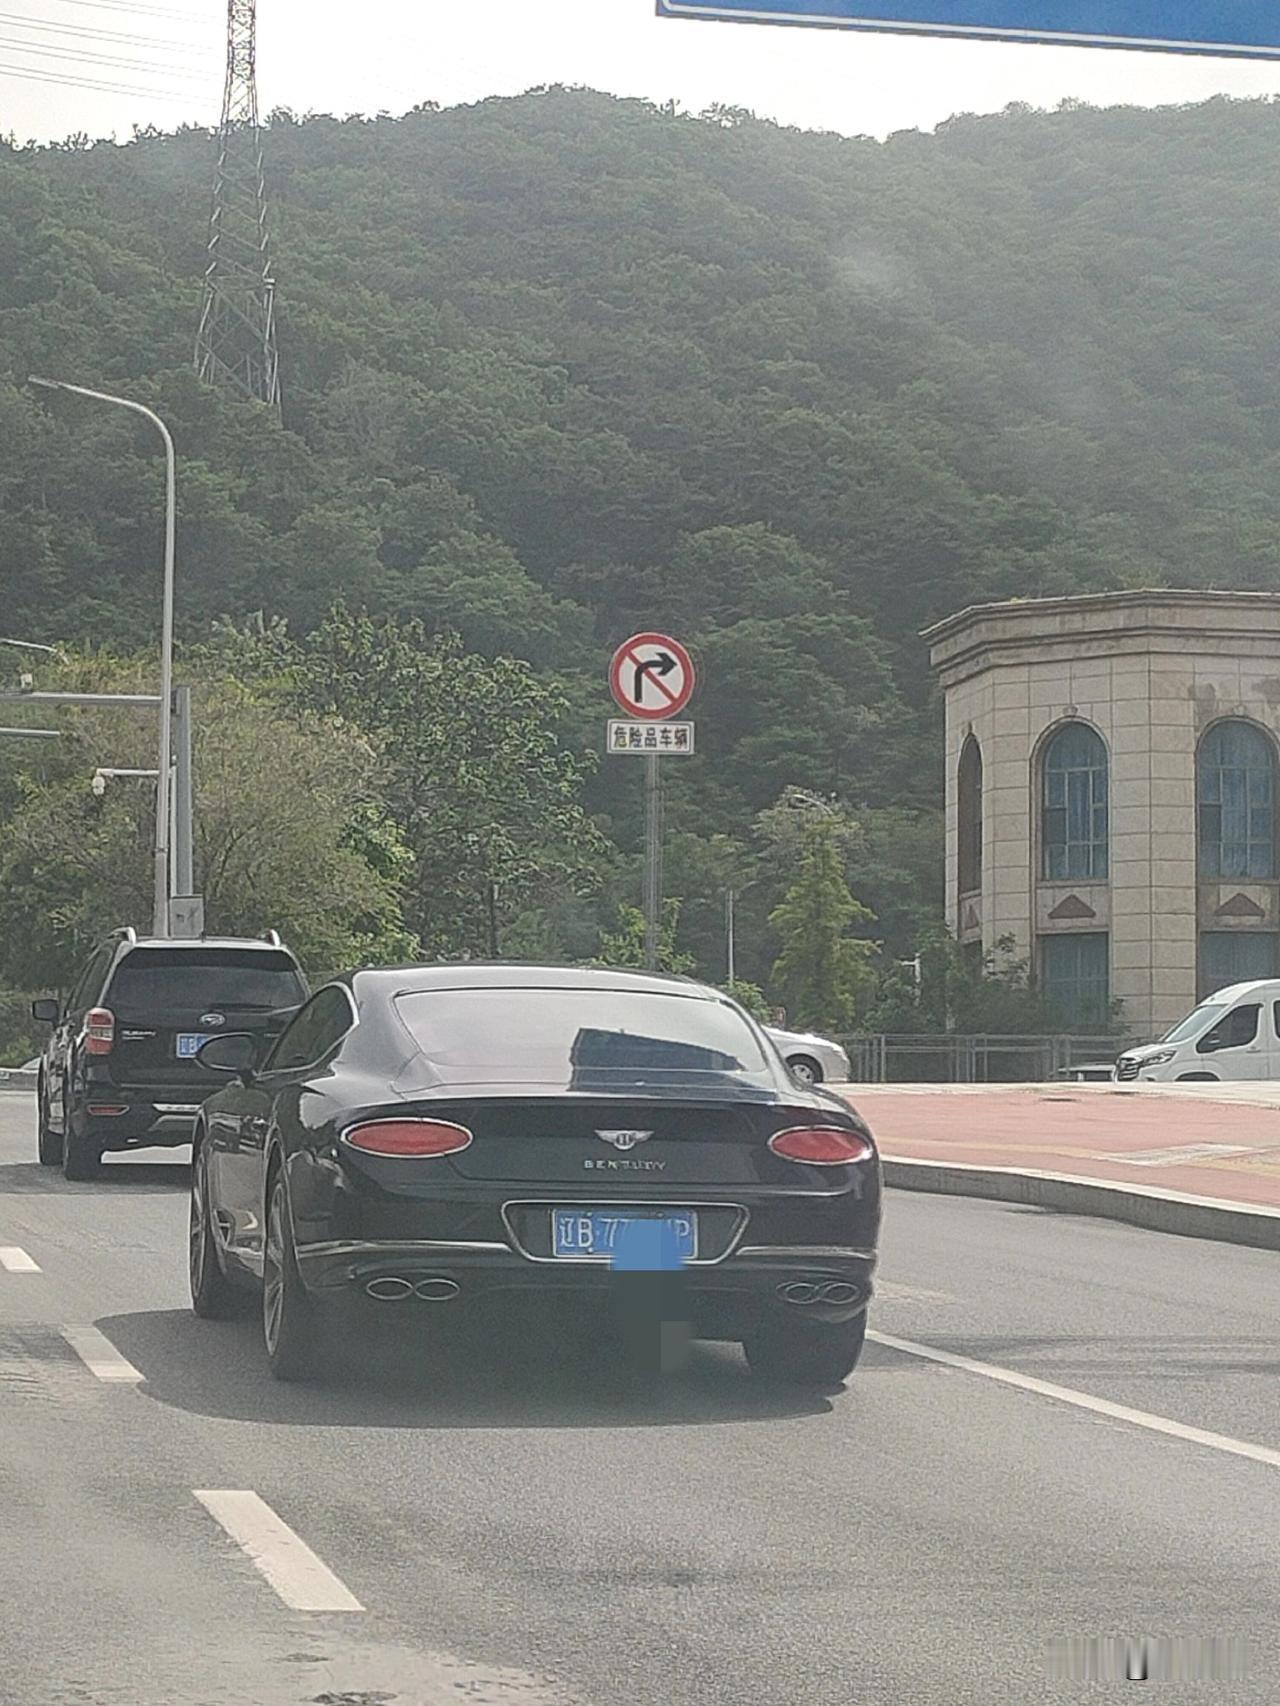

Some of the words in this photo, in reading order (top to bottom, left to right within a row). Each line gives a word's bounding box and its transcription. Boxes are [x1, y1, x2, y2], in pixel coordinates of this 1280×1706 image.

[614, 726, 688, 749] 危险品车辆
